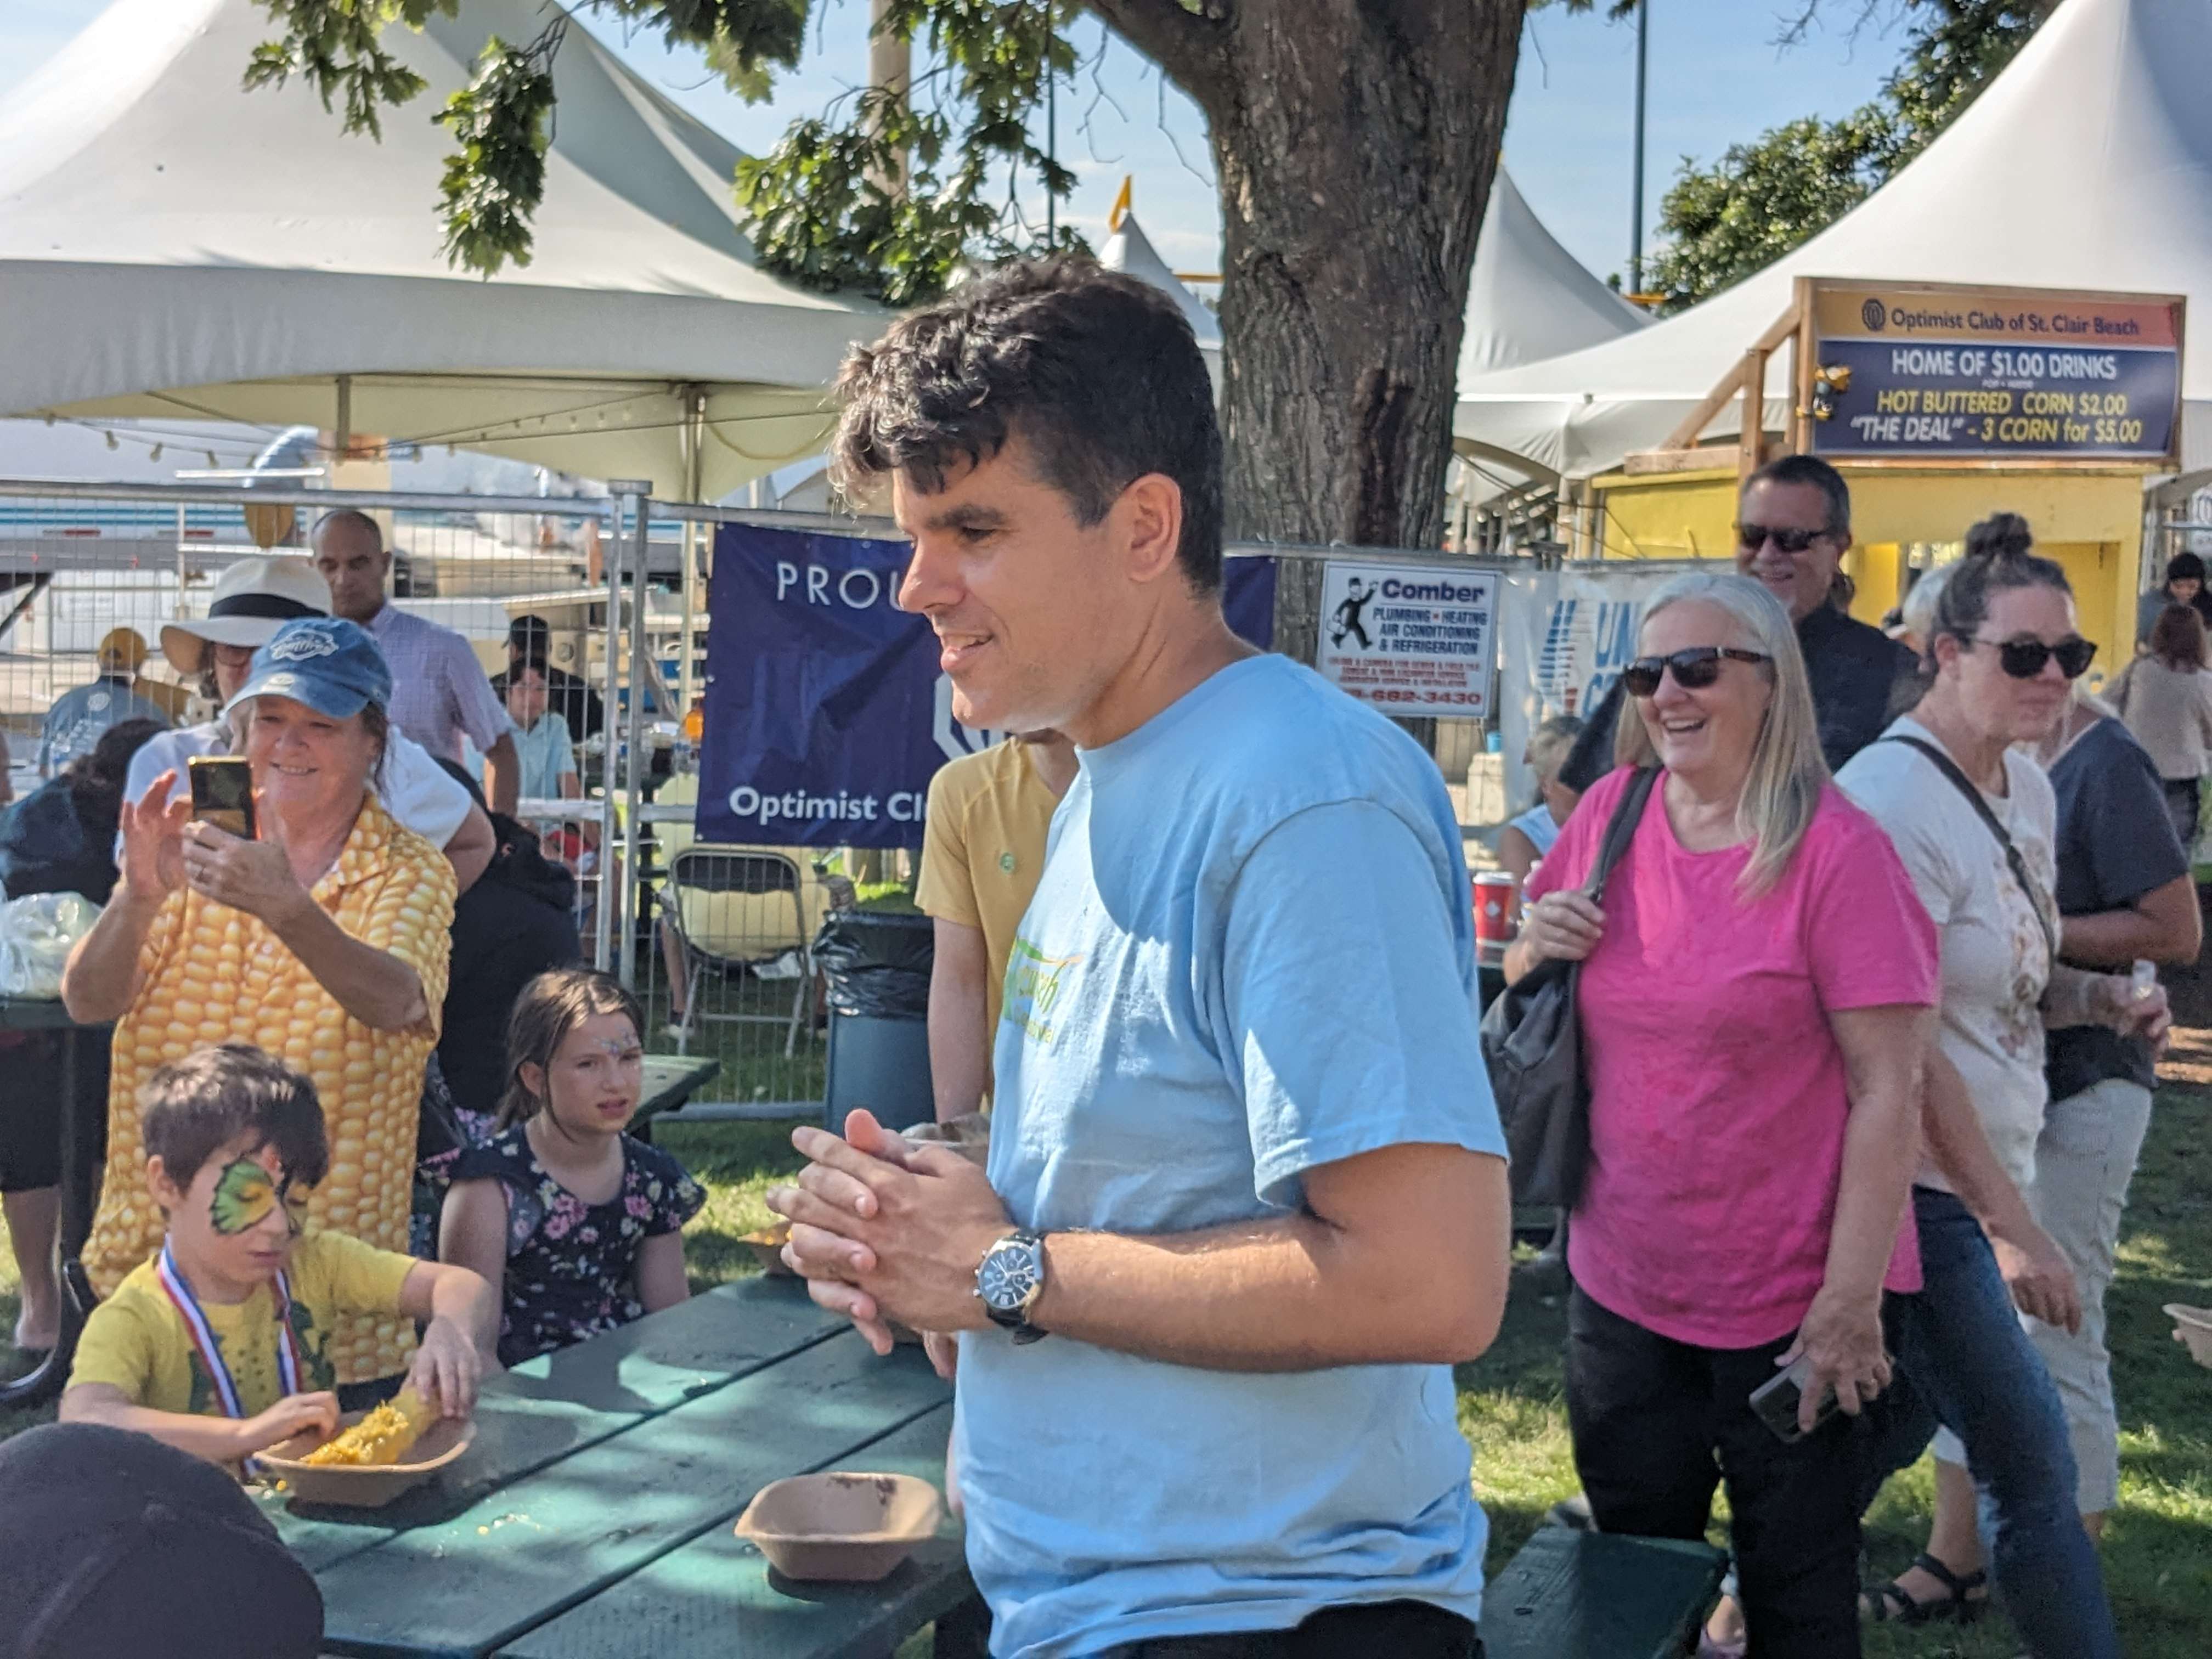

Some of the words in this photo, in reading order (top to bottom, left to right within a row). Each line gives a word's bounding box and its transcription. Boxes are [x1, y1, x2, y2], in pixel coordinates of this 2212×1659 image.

[1892, 308, 1962, 331] Optimist
[1968, 310, 2004, 330] Club
[2009, 313, 2024, 330] of
[2028, 313, 2049, 332] St.
[2052, 314, 2089, 334] Clair
[2094, 316, 2139, 335] Beach
[1893, 349, 1955, 376] HOME
[1959, 350, 1986, 377] OF
[1991, 350, 2045, 379] $1.00
[2049, 353, 2117, 380] DRINKS
[1877, 390, 1918, 413] HOT
[1922, 390, 2011, 414] BUTTERED
[2023, 392, 2074, 414] CORN
[2079, 392, 2127, 416] $2.00
[1981, 416, 1994, 442] 3
[1999, 417, 2057, 442] CORN
[2063, 417, 2090, 442] for
[2095, 417, 2142, 443] $5.00
[1381, 578, 1485, 602] Comber
[1373, 607, 1431, 622] PLUMBING
[1441, 610, 1488, 626] HEATING
[1379, 624, 1398, 637] AIR
[1403, 625, 1481, 640] CONDITIONING
[1379, 639, 1388, 652] &
[1392, 639, 1478, 655] REFRIGERATION
[729, 786, 877, 825] Optimist
[887, 791, 926, 822] Cl
